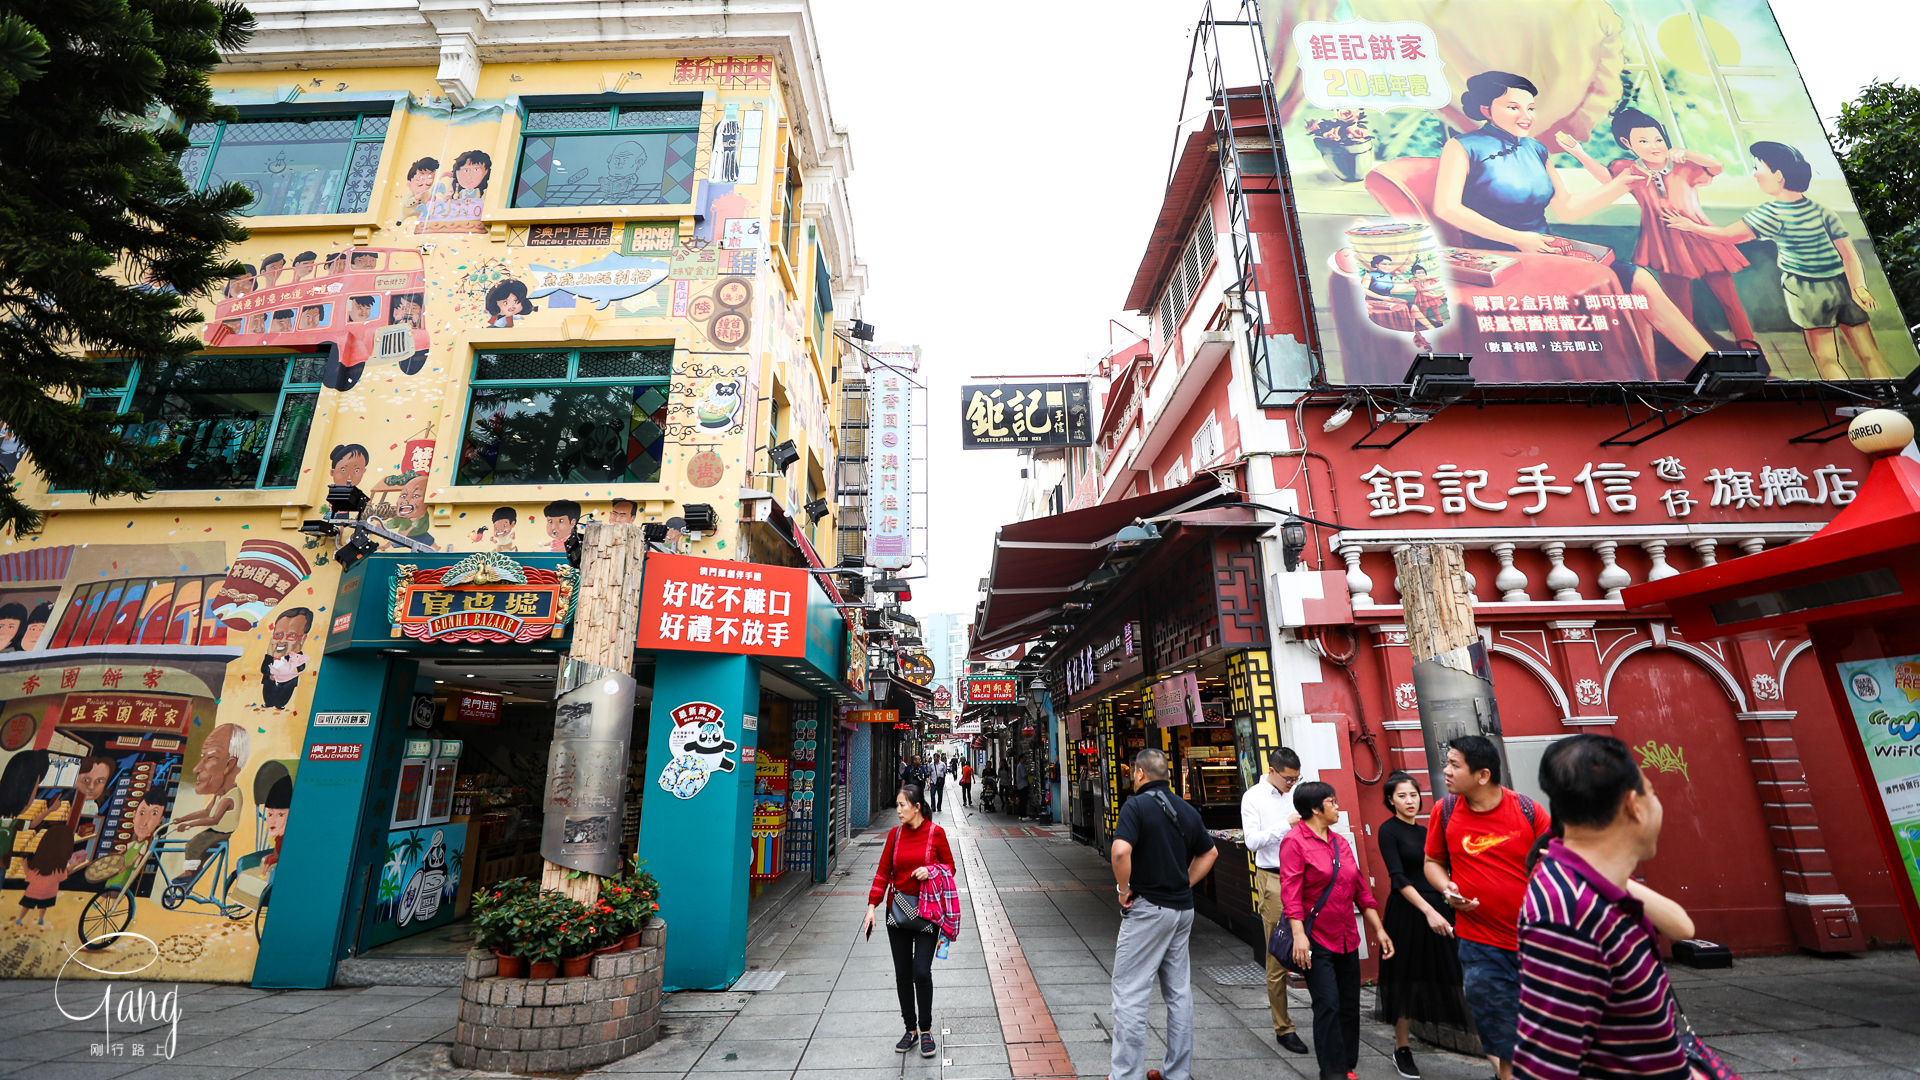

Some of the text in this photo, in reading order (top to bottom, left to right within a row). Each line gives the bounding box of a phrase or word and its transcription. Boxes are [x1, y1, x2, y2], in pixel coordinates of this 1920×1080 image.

[1309, 34, 1426, 60] 鉅記餅家
[675, 55, 772, 83] 新中央
[1324, 68, 1430, 97] 20週年慶
[535, 226, 608, 239] 澳門佳作
[634, 227, 675, 240] BANG!
[632, 239, 673, 252] BANG!
[672, 249, 716, 262] 公主
[966, 388, 1052, 437] 鉅記
[1053, 409, 1066, 434] 手信
[1849, 423, 1883, 441] CORREIO
[879, 376, 900, 533] 咀香園之澳門佳作
[1360, 461, 1641, 518] 鉅記手信
[1703, 463, 1859, 509] 旗艦店
[699, 566, 762, 582] 澳門原創伴手禮
[421, 592, 540, 616] 官也墟
[662, 579, 791, 617] 好吃不離口
[434, 613, 515, 632] CUNHA BAZAAR
[659, 612, 790, 648] 好禮不放手
[22, 667, 164, 695] 香園餅家
[971, 683, 1013, 694] 澳門郵票
[461, 697, 498, 712] 澳門佳作
[678, 705, 717, 720] 最新商品
[70, 705, 179, 727] 咀香園餅家
[311, 745, 360, 753] 澳門佳作
